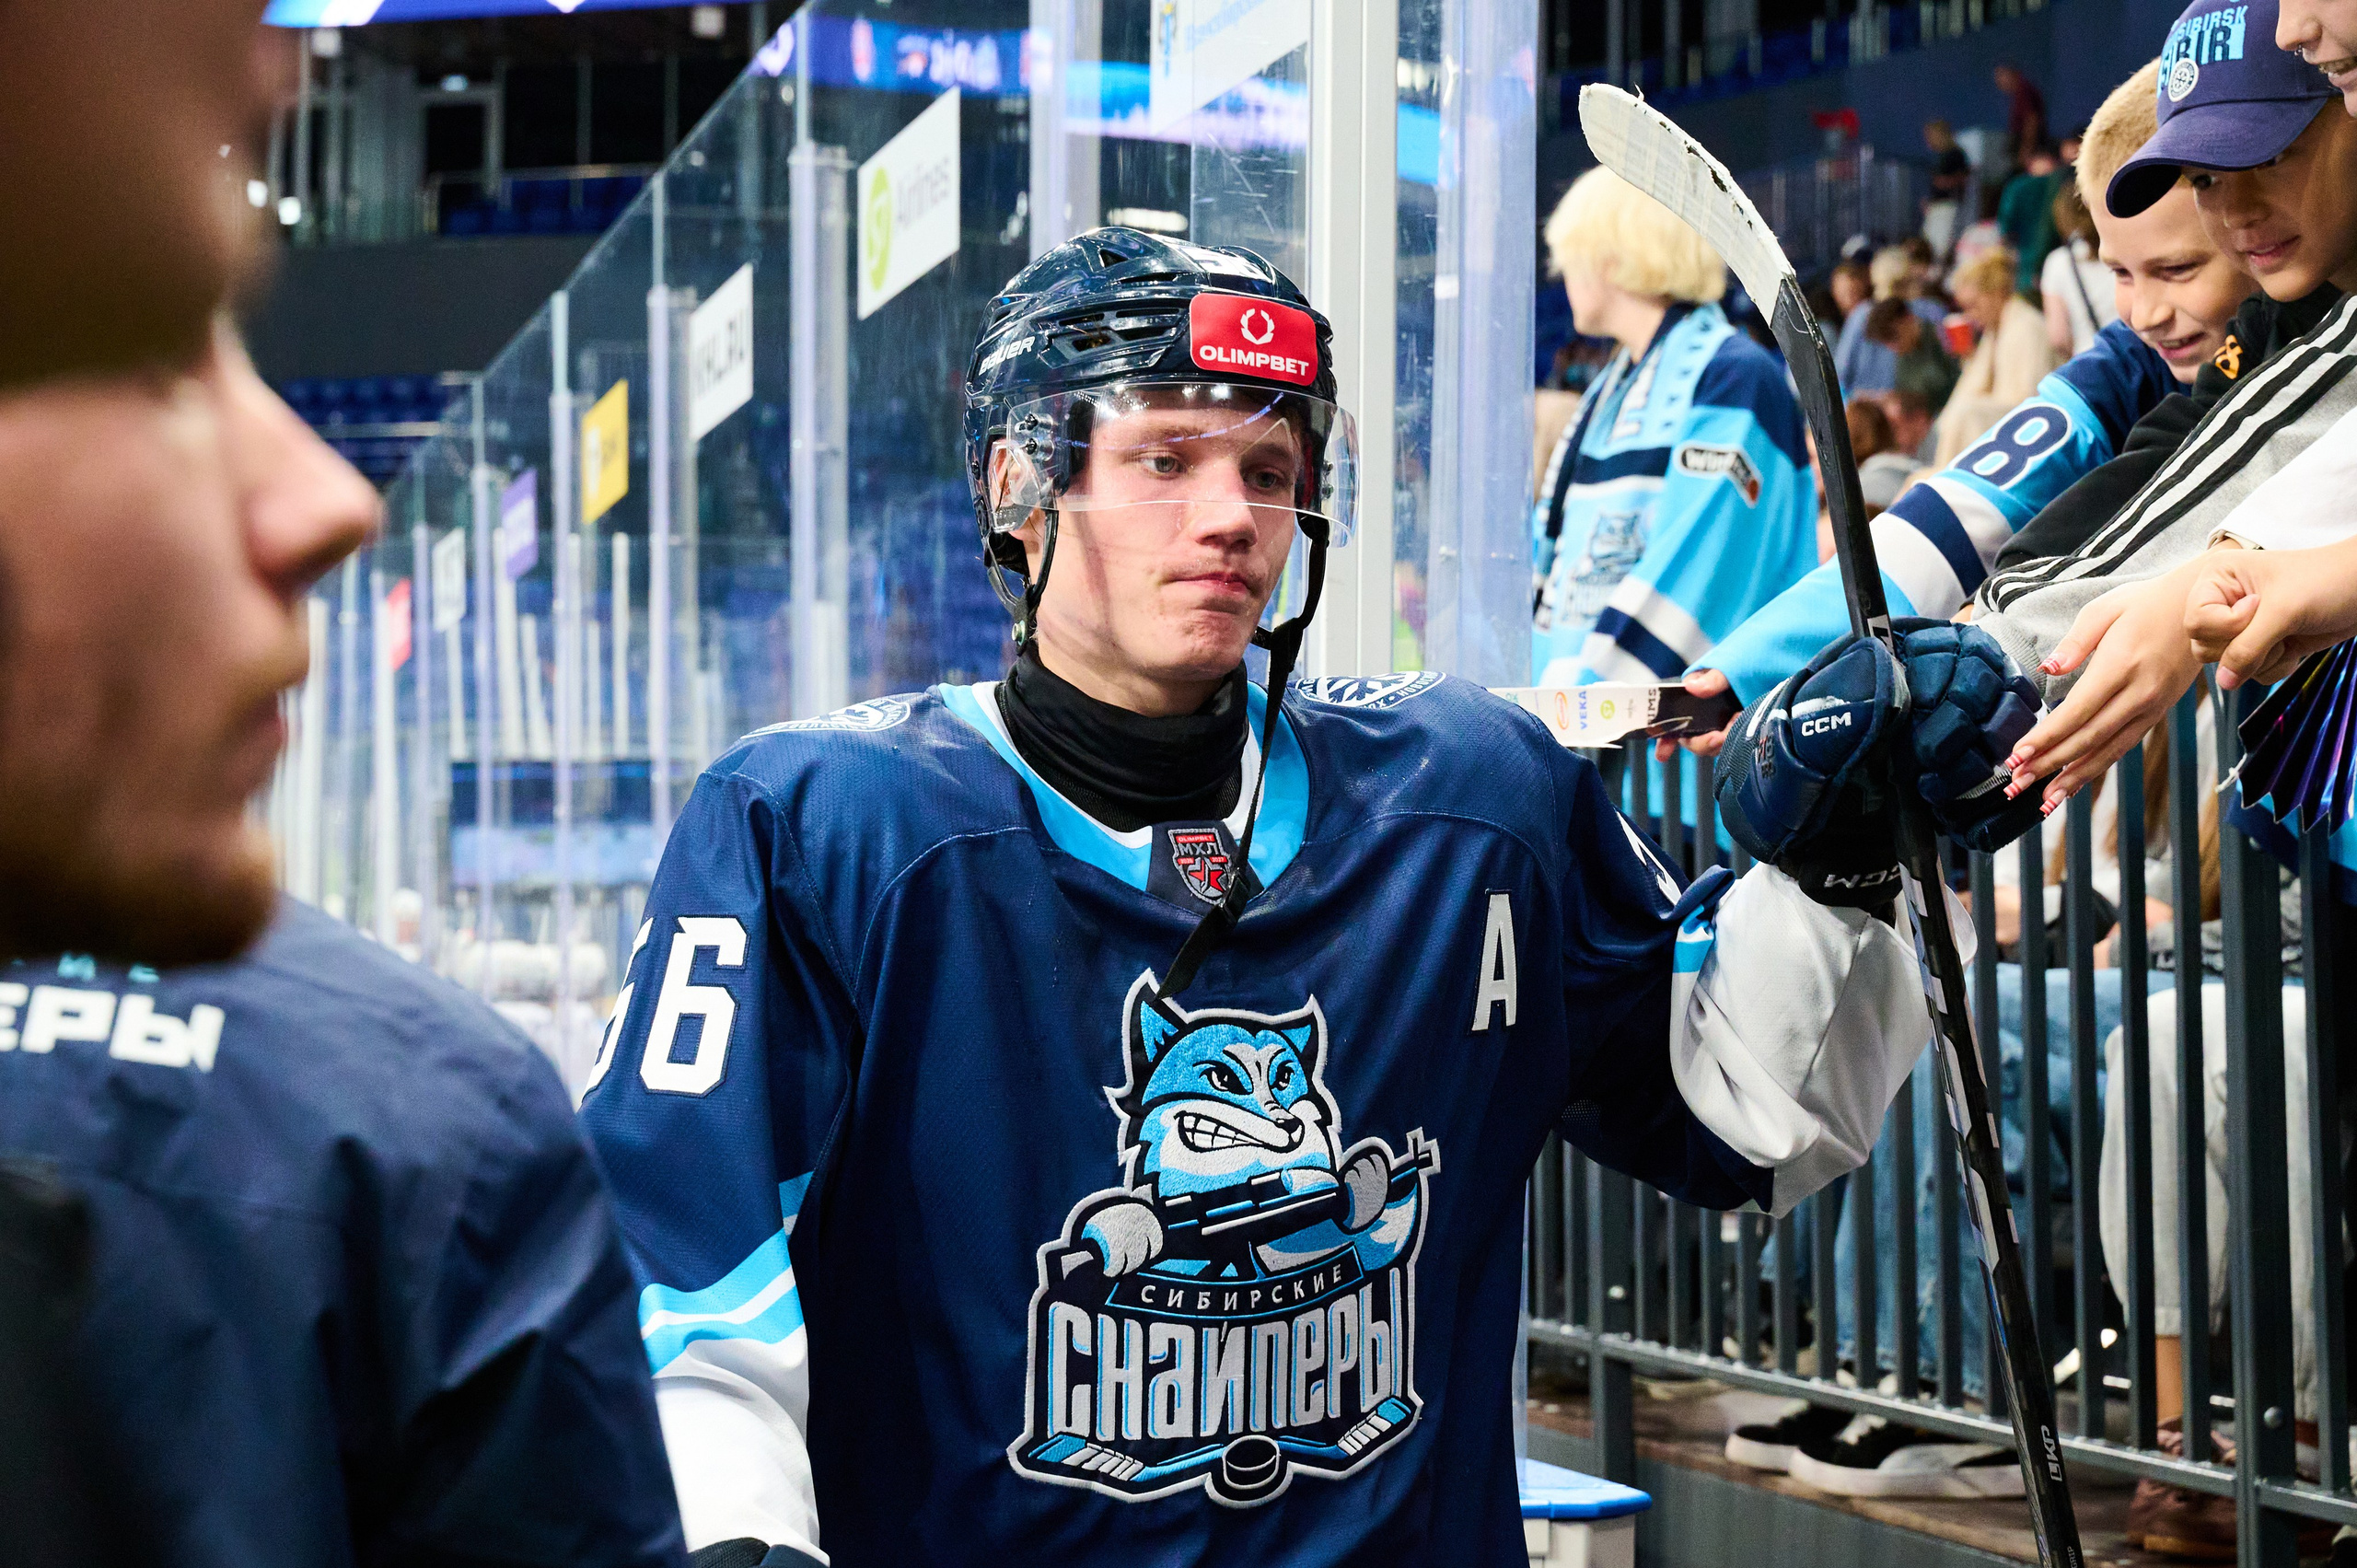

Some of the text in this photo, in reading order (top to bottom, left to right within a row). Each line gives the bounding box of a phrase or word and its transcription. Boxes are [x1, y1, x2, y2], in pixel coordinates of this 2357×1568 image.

[979, 336, 1035, 376] BAUER
[1199, 344, 1309, 377] OLIMPBET
[1575, 691, 1588, 730] VEKA
[1801, 712, 1852, 737] CCM
[1178, 834, 1213, 842] OLIMPBET
[1178, 842, 1219, 856] МХЛ
[1472, 894, 1517, 1030] A
[1141, 1263, 1343, 1311] СИБИРСКИЕ
